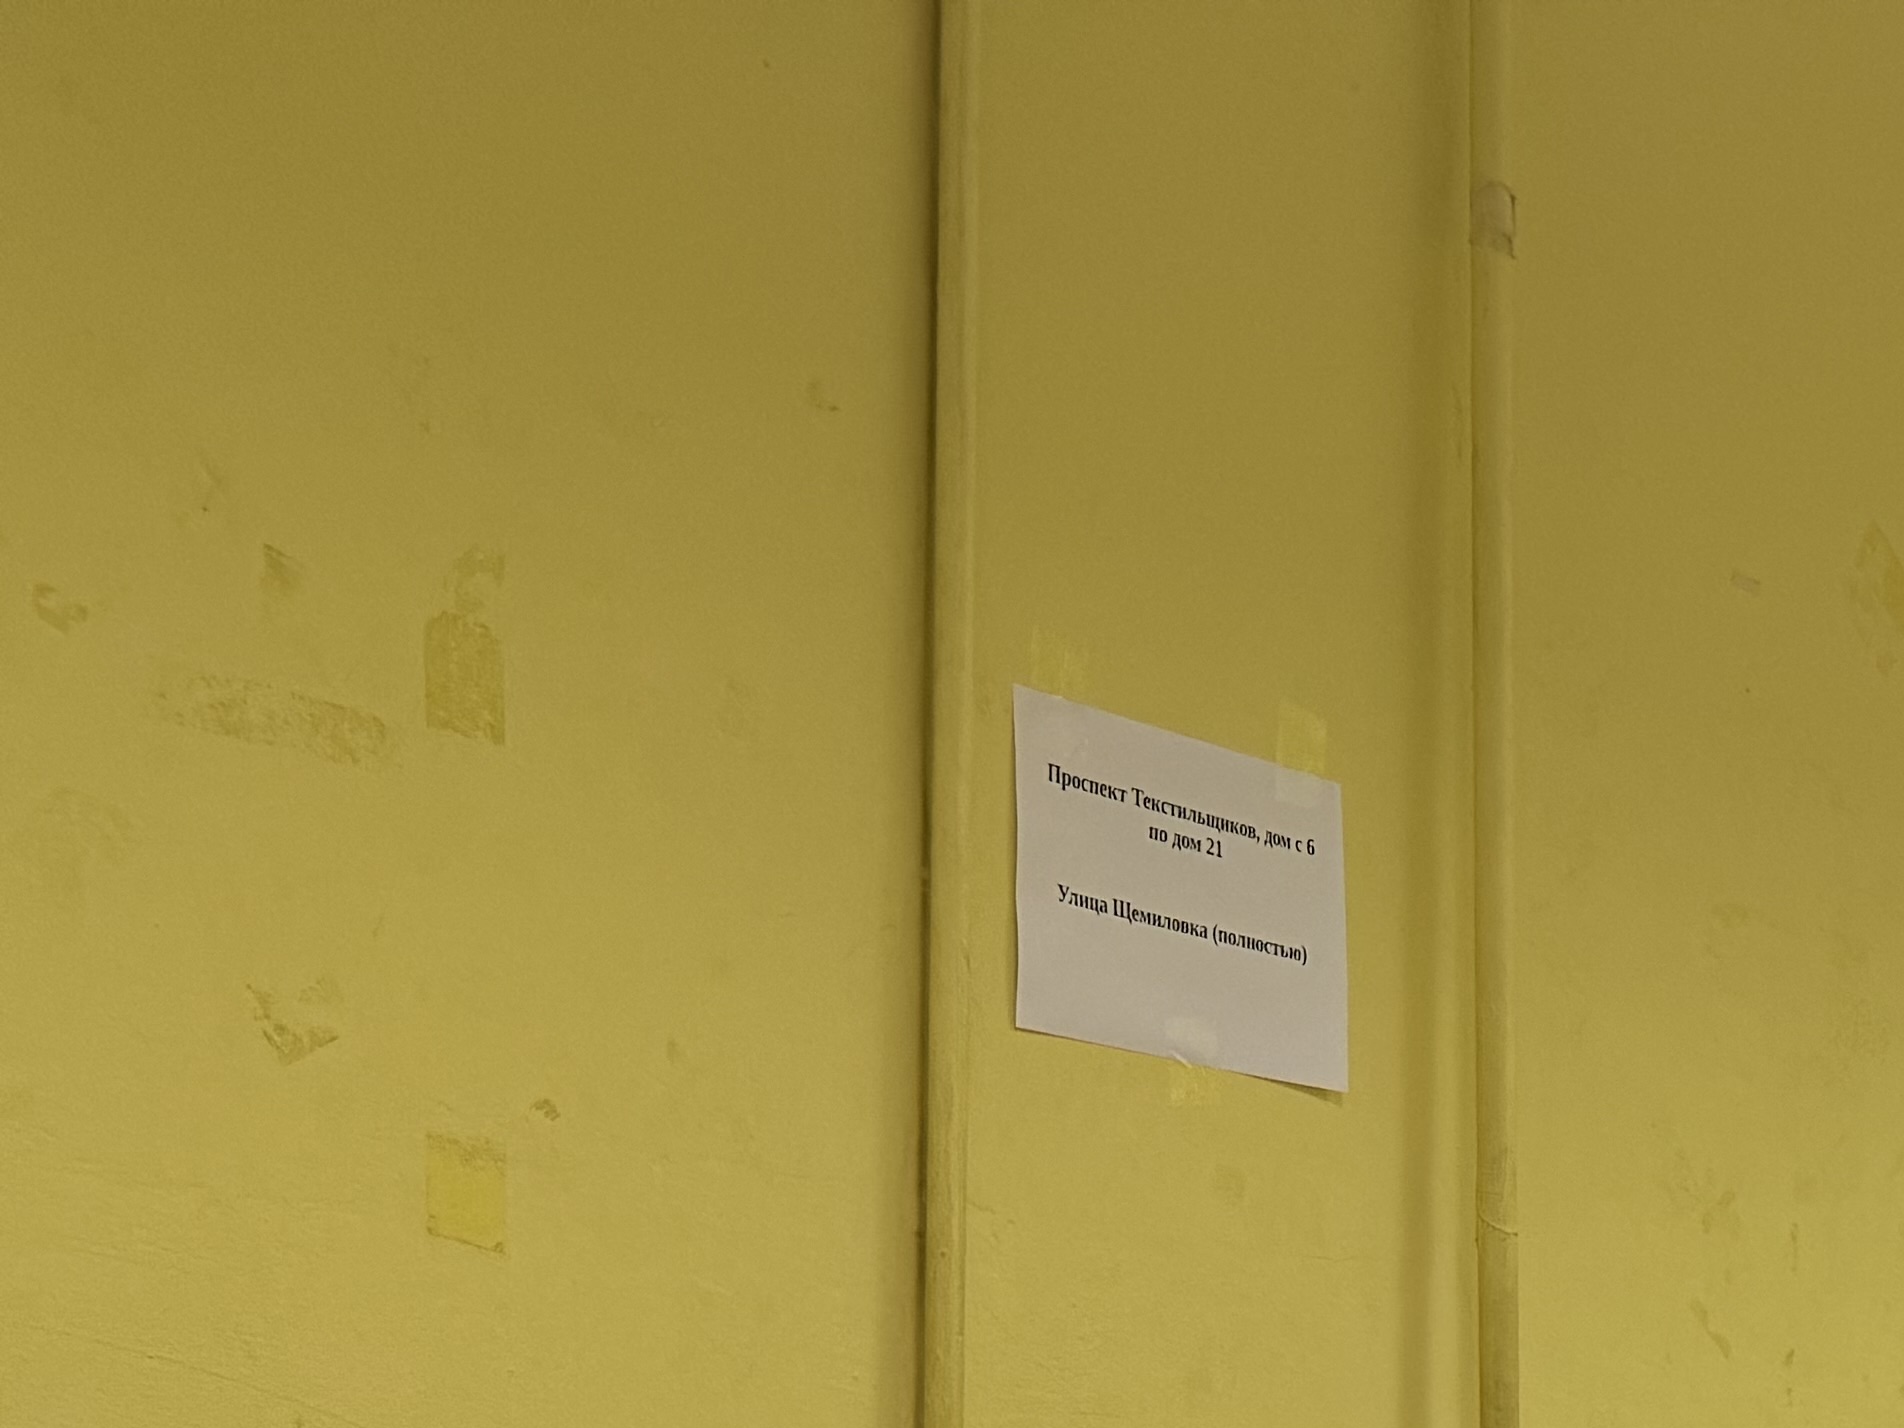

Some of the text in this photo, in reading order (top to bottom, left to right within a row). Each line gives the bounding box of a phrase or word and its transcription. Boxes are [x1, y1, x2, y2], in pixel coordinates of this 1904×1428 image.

[1048, 763, 1316, 856] Проспект Текстильщиков, дом с 6
[1149, 825, 1223, 858] по дом 21
[1057, 883, 1308, 966] Улица Щемиловка (полностью)
